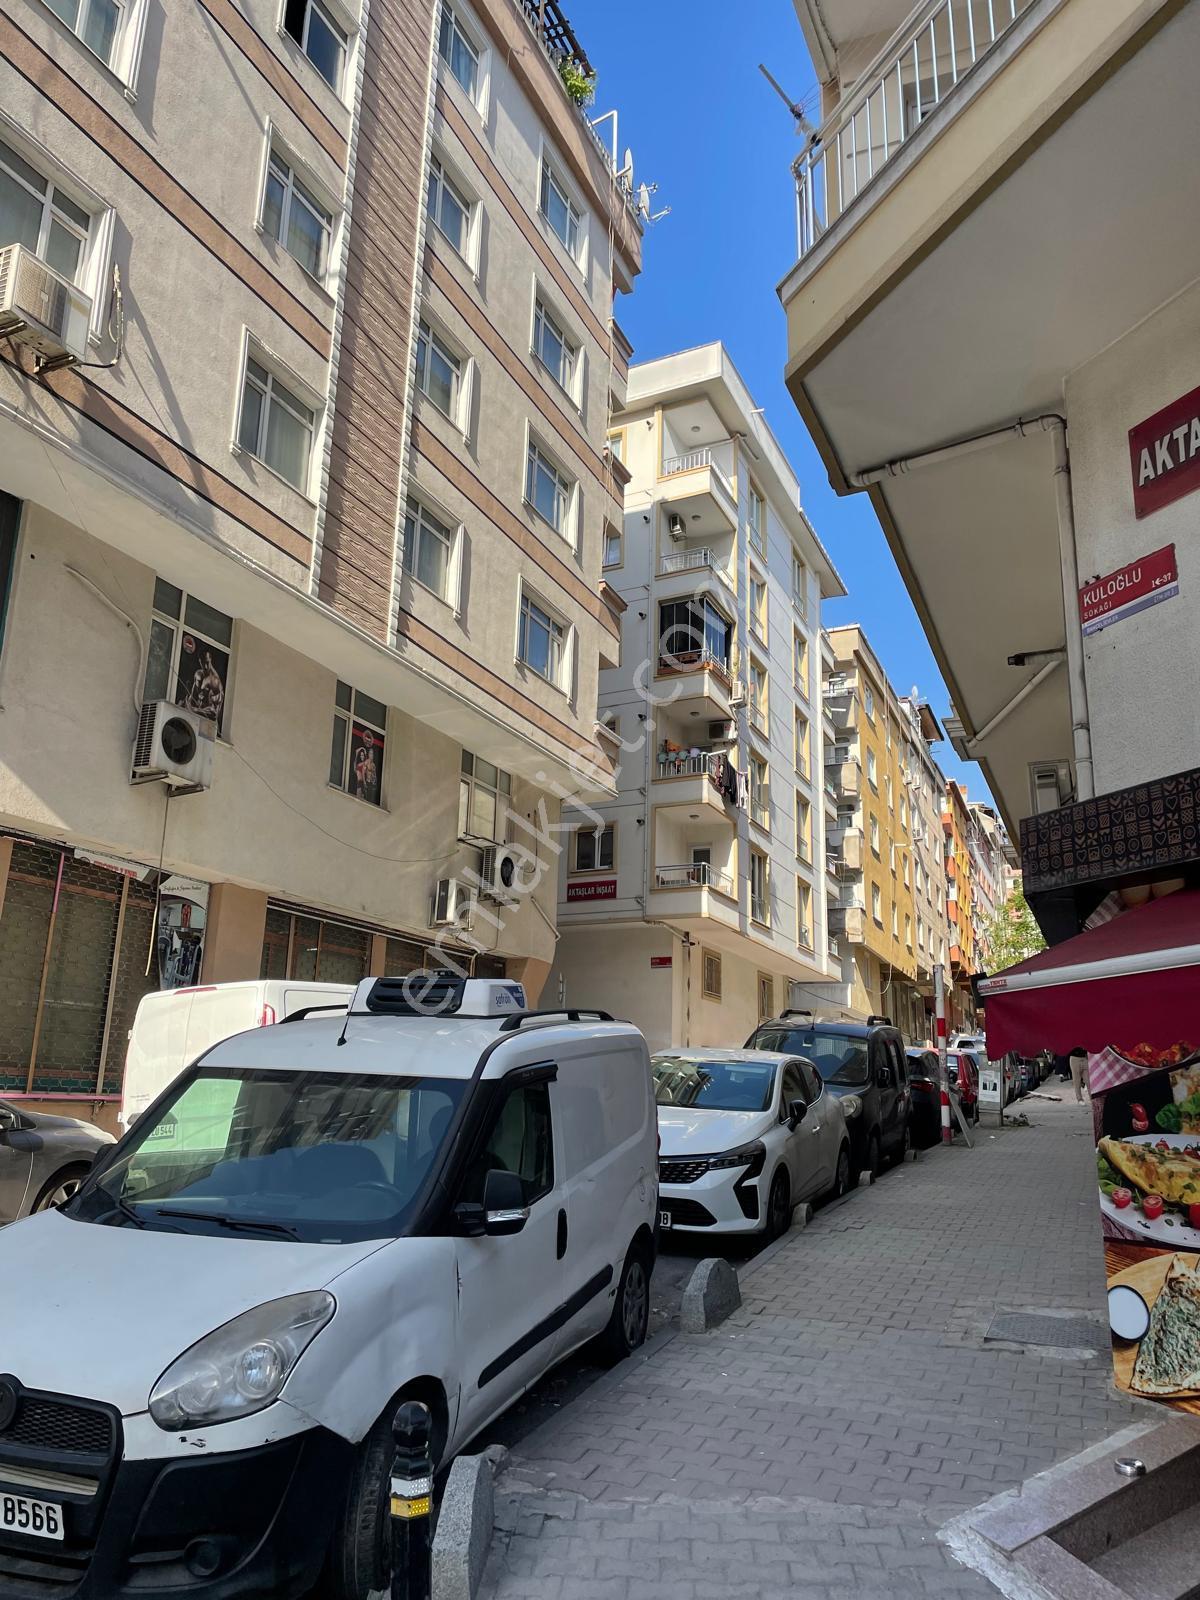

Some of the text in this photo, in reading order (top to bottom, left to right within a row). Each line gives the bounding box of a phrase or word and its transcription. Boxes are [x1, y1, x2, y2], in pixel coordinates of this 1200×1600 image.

[1138, 416, 1200, 487] AKTA
[1083, 568, 1142, 607] KULOĞLU
[1083, 600, 1112, 619] SOKAĞI
[568, 887, 595, 897] AKTAŞLAR
[3, 1497, 59, 1535] 8566
